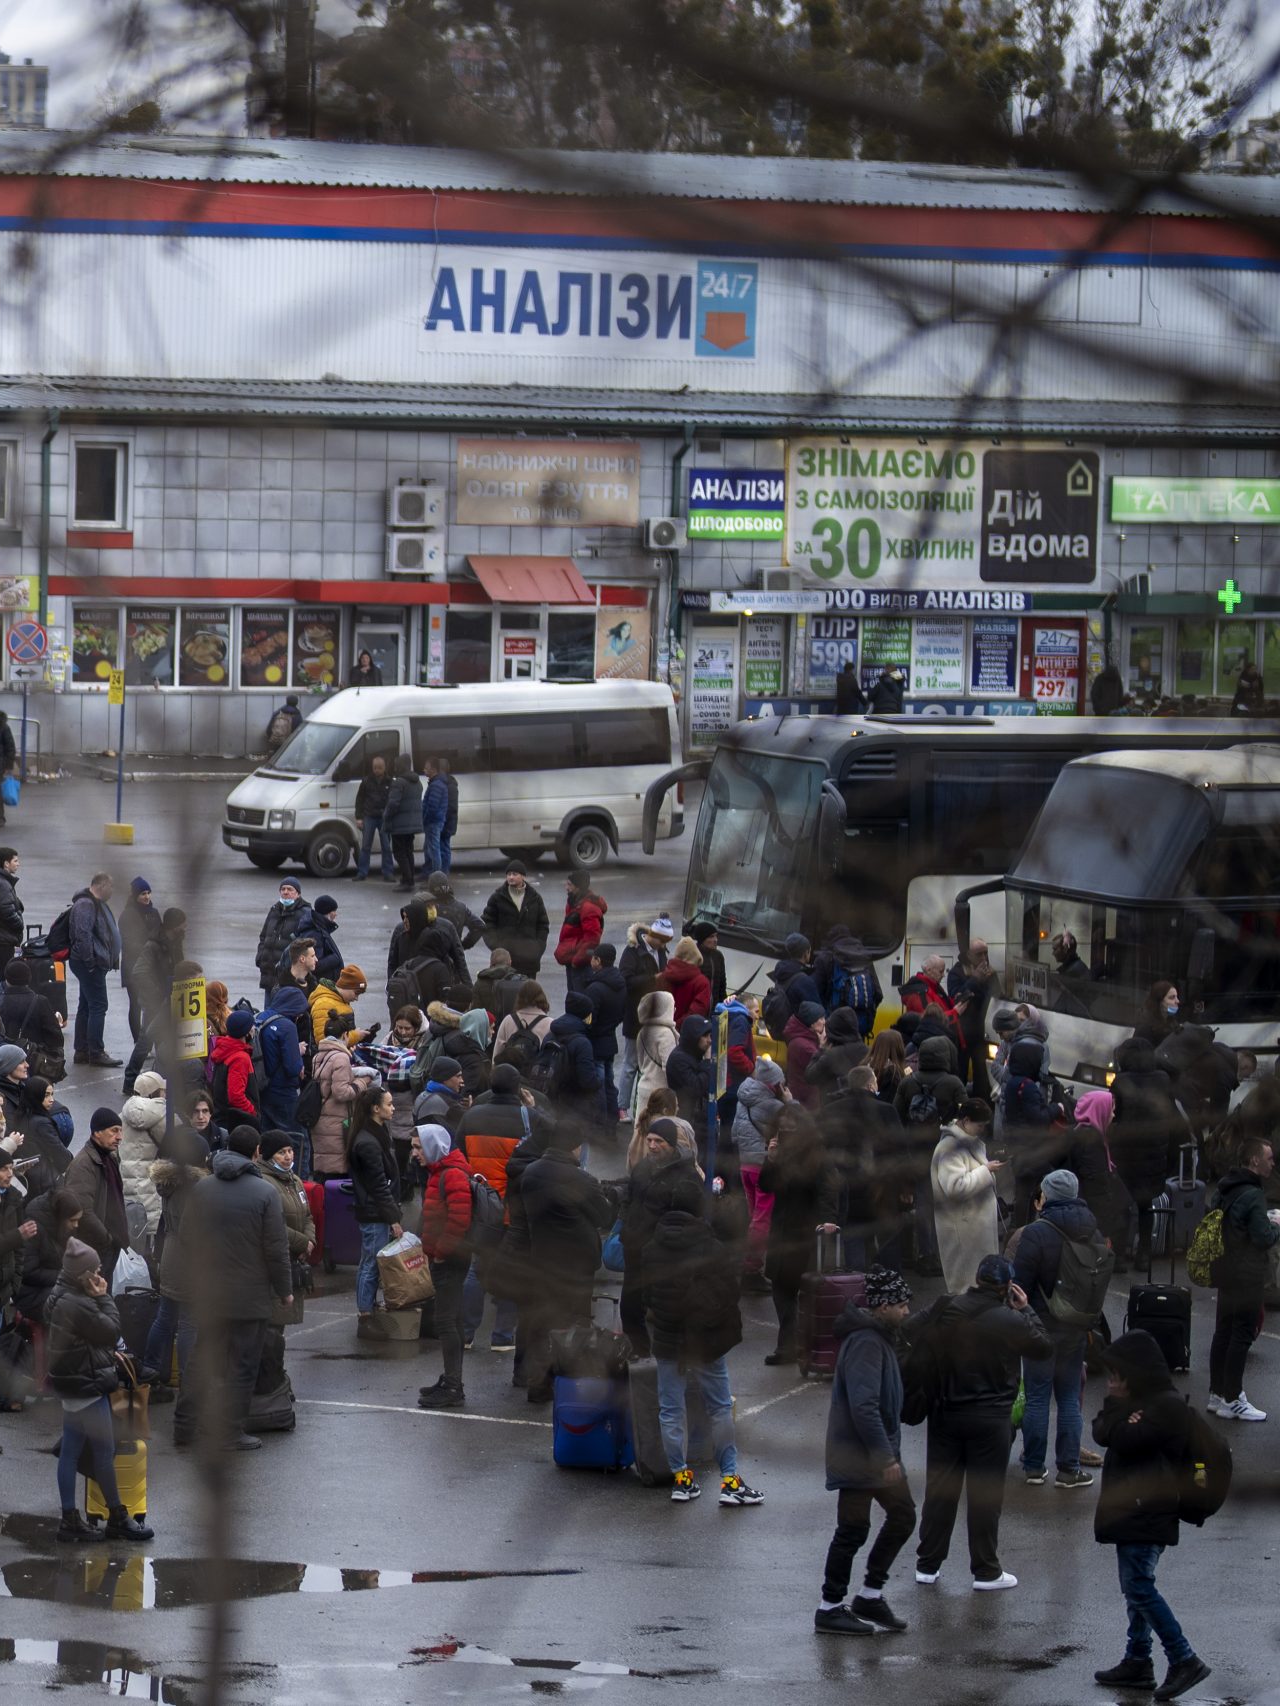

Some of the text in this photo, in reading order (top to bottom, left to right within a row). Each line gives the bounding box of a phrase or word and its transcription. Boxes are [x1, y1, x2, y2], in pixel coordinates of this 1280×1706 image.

[424, 267, 753, 339] АНАЛІЗИ 24/7
[463, 451, 635, 473] НАЙНИЖЧІ ЦІНИ
[797, 447, 975, 479] ЗНІМАЄМО
[466, 480, 529, 498] ОДЯГ
[691, 478, 784, 501] АНАЛІЗИ
[815, 487, 975, 514] САМОІЗОЛЯЦІЇ
[988, 489, 1042, 527] Дій
[1147, 490, 1271, 512] АПТЕКА
[690, 512, 783, 534] ЦІЛОДОБОВО
[809, 517, 882, 580] 30
[886, 538, 975, 560] ХВИЛИН
[988, 534, 1089, 562] вдома
[924, 590, 1025, 610] АНАЛІЗІВ
[811, 618, 856, 638] ПЛР
[975, 624, 1016, 632] АНАЛІЗІВ
[811, 641, 854, 667] 599
[1036, 657, 1078, 668] АНТИГЕН
[112, 672, 121, 685] 24
[1037, 681, 1065, 696] 297
[178, 991, 200, 1017] 15
